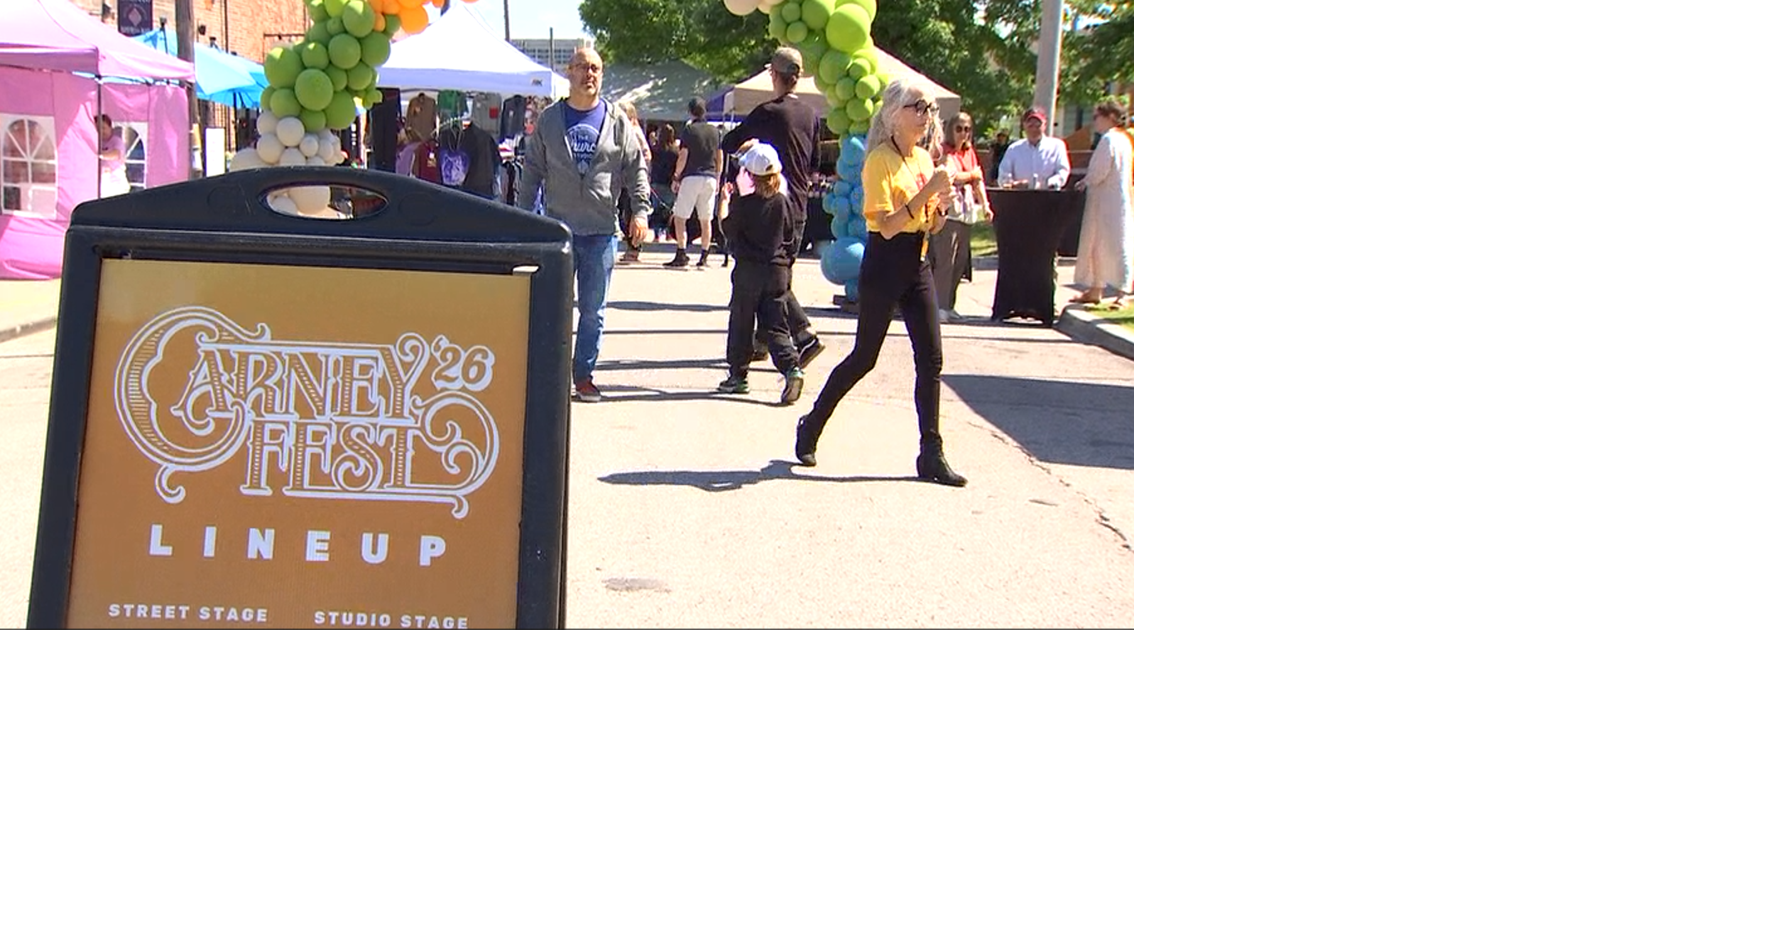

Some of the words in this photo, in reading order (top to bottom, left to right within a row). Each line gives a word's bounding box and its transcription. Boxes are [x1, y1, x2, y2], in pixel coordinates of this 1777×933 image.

[115, 305, 430, 503] CARNEY
[240, 391, 500, 519] FEST
[149, 524, 446, 566] LINEUP
[108, 603, 190, 619] STREET
[199, 606, 268, 622] STAGE
[314, 610, 391, 627] STUDIO
[400, 614, 468, 629] STAGE
